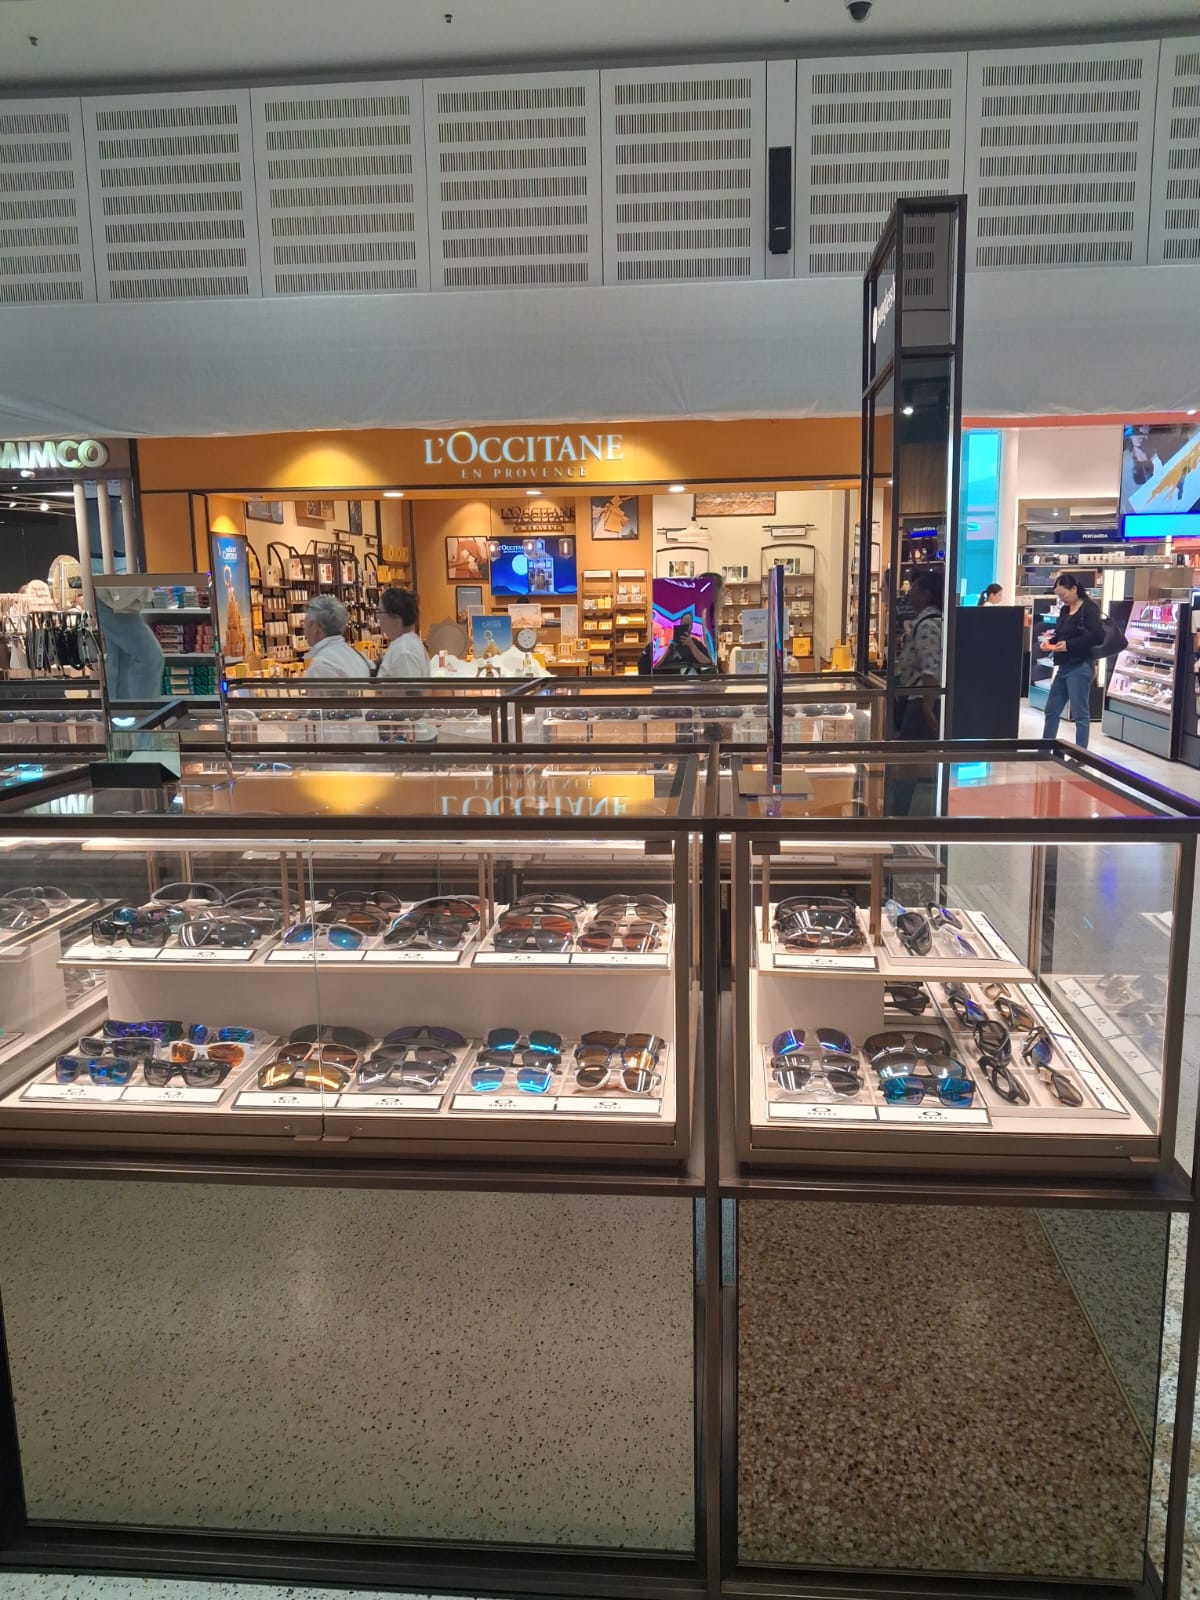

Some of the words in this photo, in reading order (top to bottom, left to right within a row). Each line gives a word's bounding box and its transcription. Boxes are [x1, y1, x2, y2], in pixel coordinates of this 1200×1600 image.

[424, 431, 625, 464] L'OCCITANE
[461, 468, 483, 480] EN
[494, 466, 586, 479] PROVENCE
